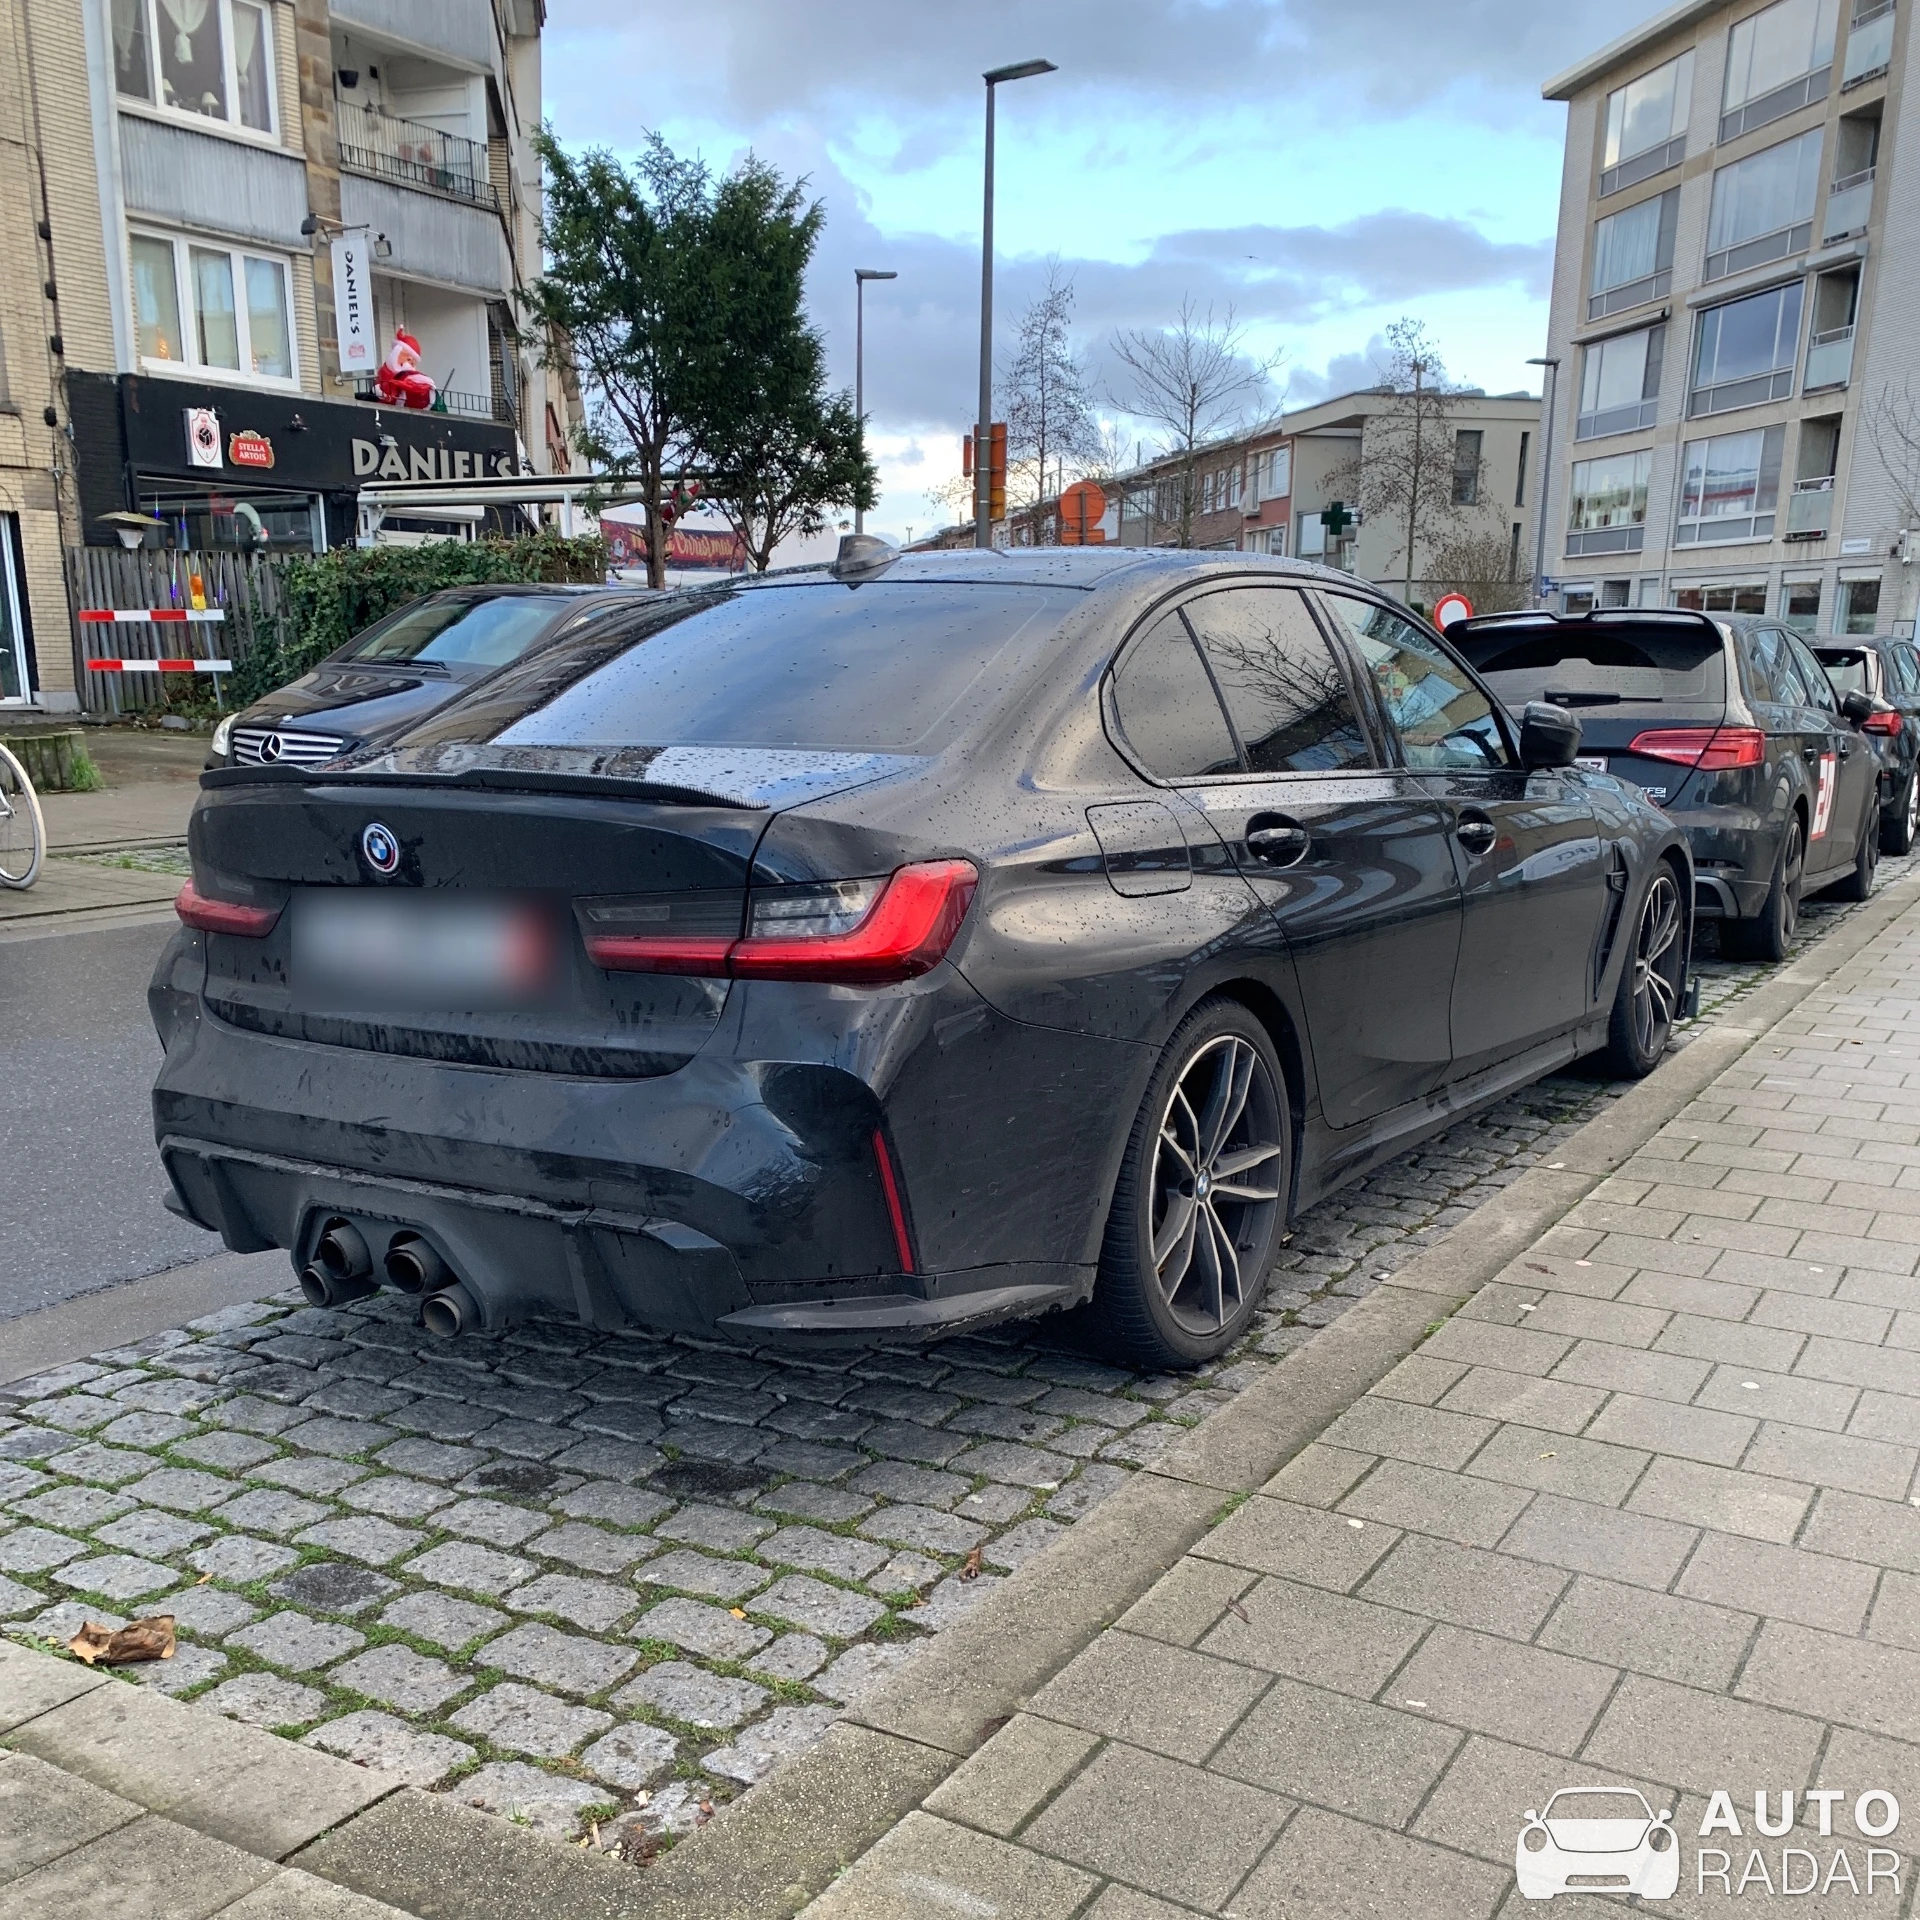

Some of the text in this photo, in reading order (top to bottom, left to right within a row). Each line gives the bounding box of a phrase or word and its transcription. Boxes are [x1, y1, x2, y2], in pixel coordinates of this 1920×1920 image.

[344, 250, 360, 334] DANIEL'S
[238, 442, 265, 452] STELLA
[239, 451, 267, 461] ARTOIS
[351, 438, 513, 480] DANIEL'S
